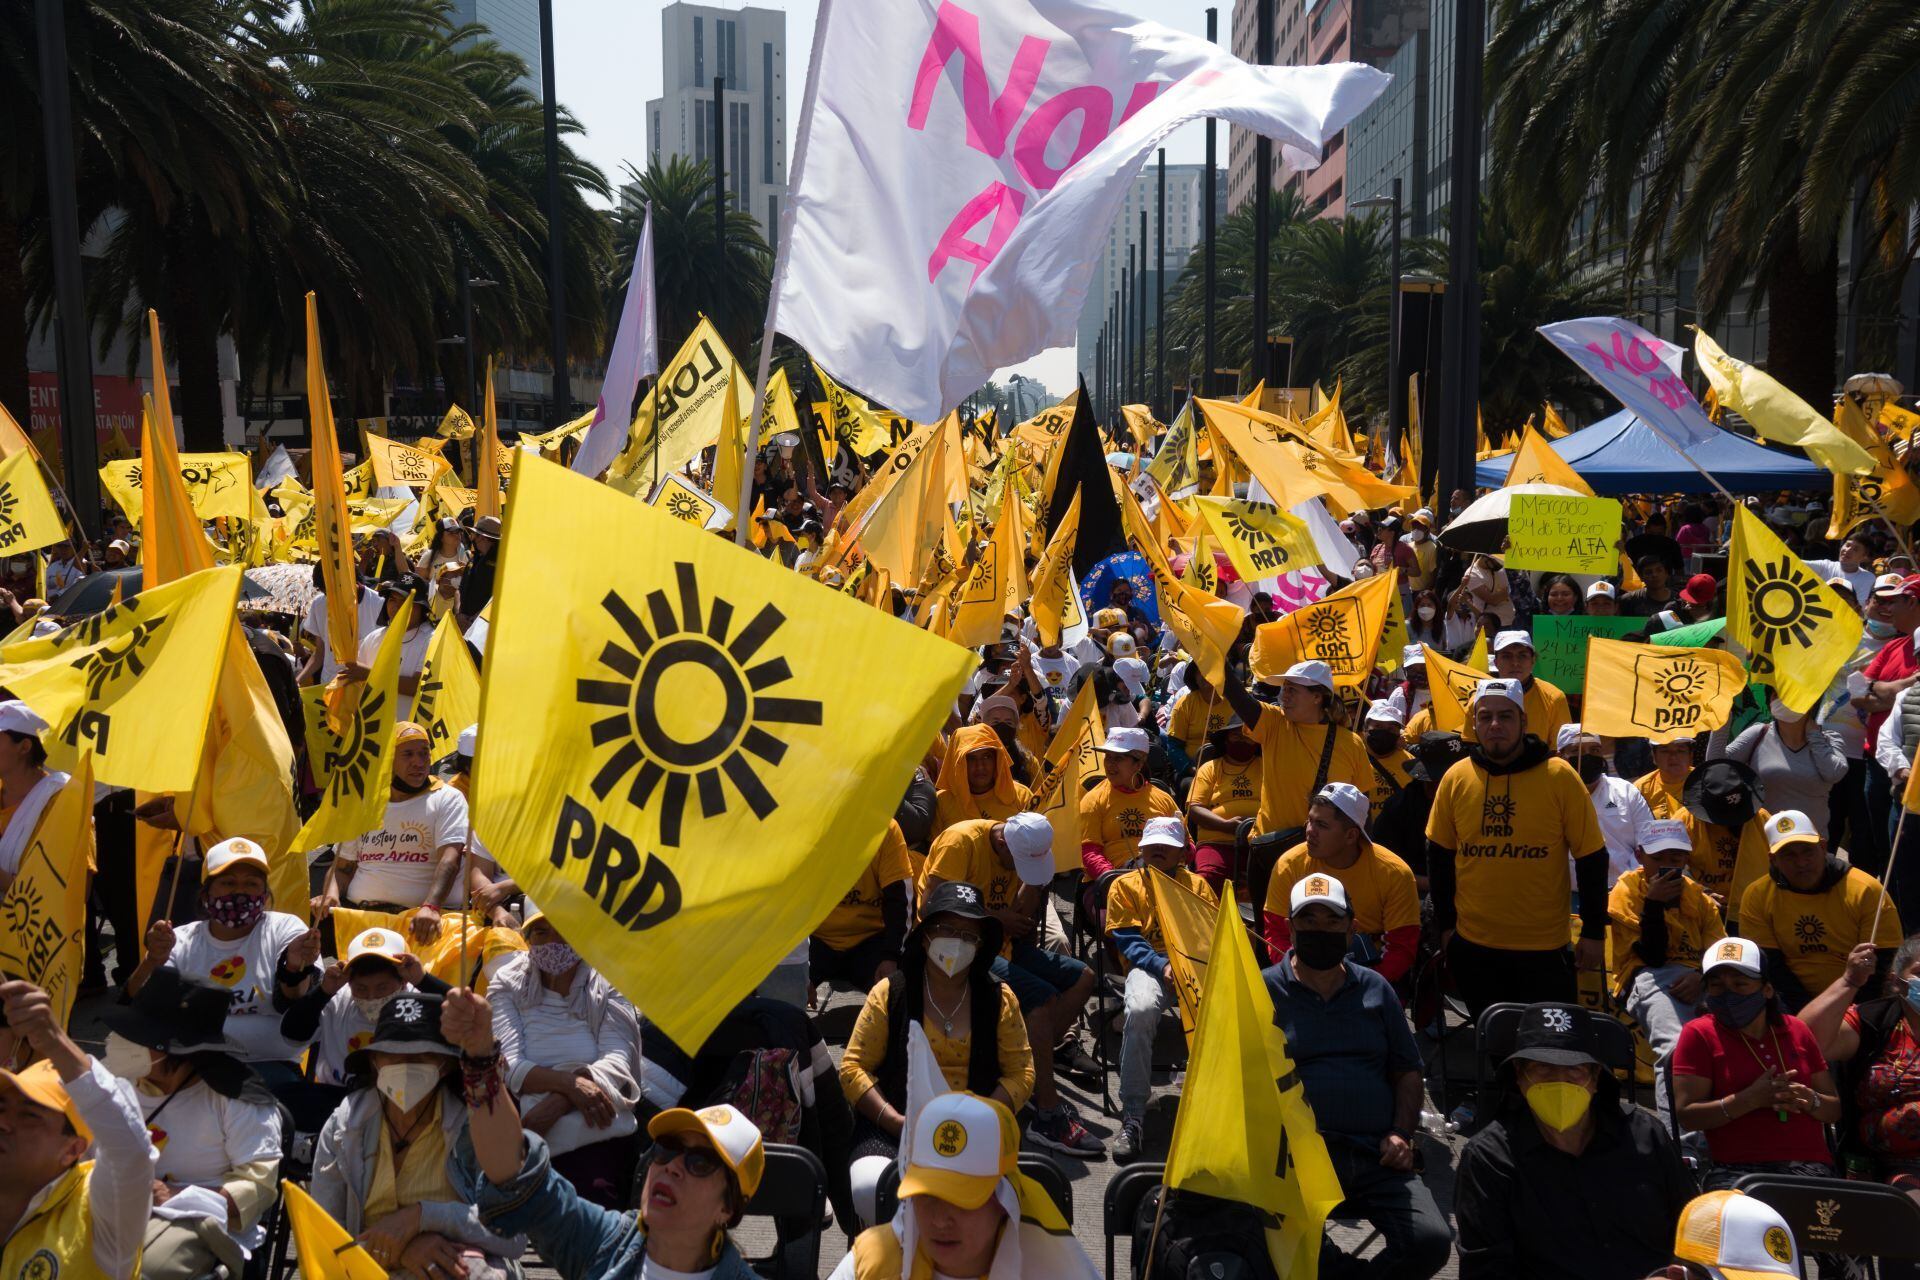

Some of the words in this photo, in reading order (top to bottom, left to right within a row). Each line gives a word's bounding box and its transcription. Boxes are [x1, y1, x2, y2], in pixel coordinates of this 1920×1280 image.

[1521, 495, 1588, 515] Mercado
[1538, 520, 1552, 536] de
[1250, 546, 1289, 571] PRD
[1552, 547, 1561, 557] a
[1654, 704, 1701, 728] PRD
[1232, 789, 1253, 799] PRD
[371, 830, 397, 849] estoy
[400, 833, 418, 843] con
[1485, 825, 1514, 837] PRD
[357, 850, 384, 863] Nora
[385, 850, 429, 863] Arias
[1459, 841, 1498, 857] Nora
[1500, 843, 1549, 858] Arias
[549, 794, 682, 932] PRD
[1542, 1008, 1565, 1027] 33
[938, 1143, 957, 1153] PRD
